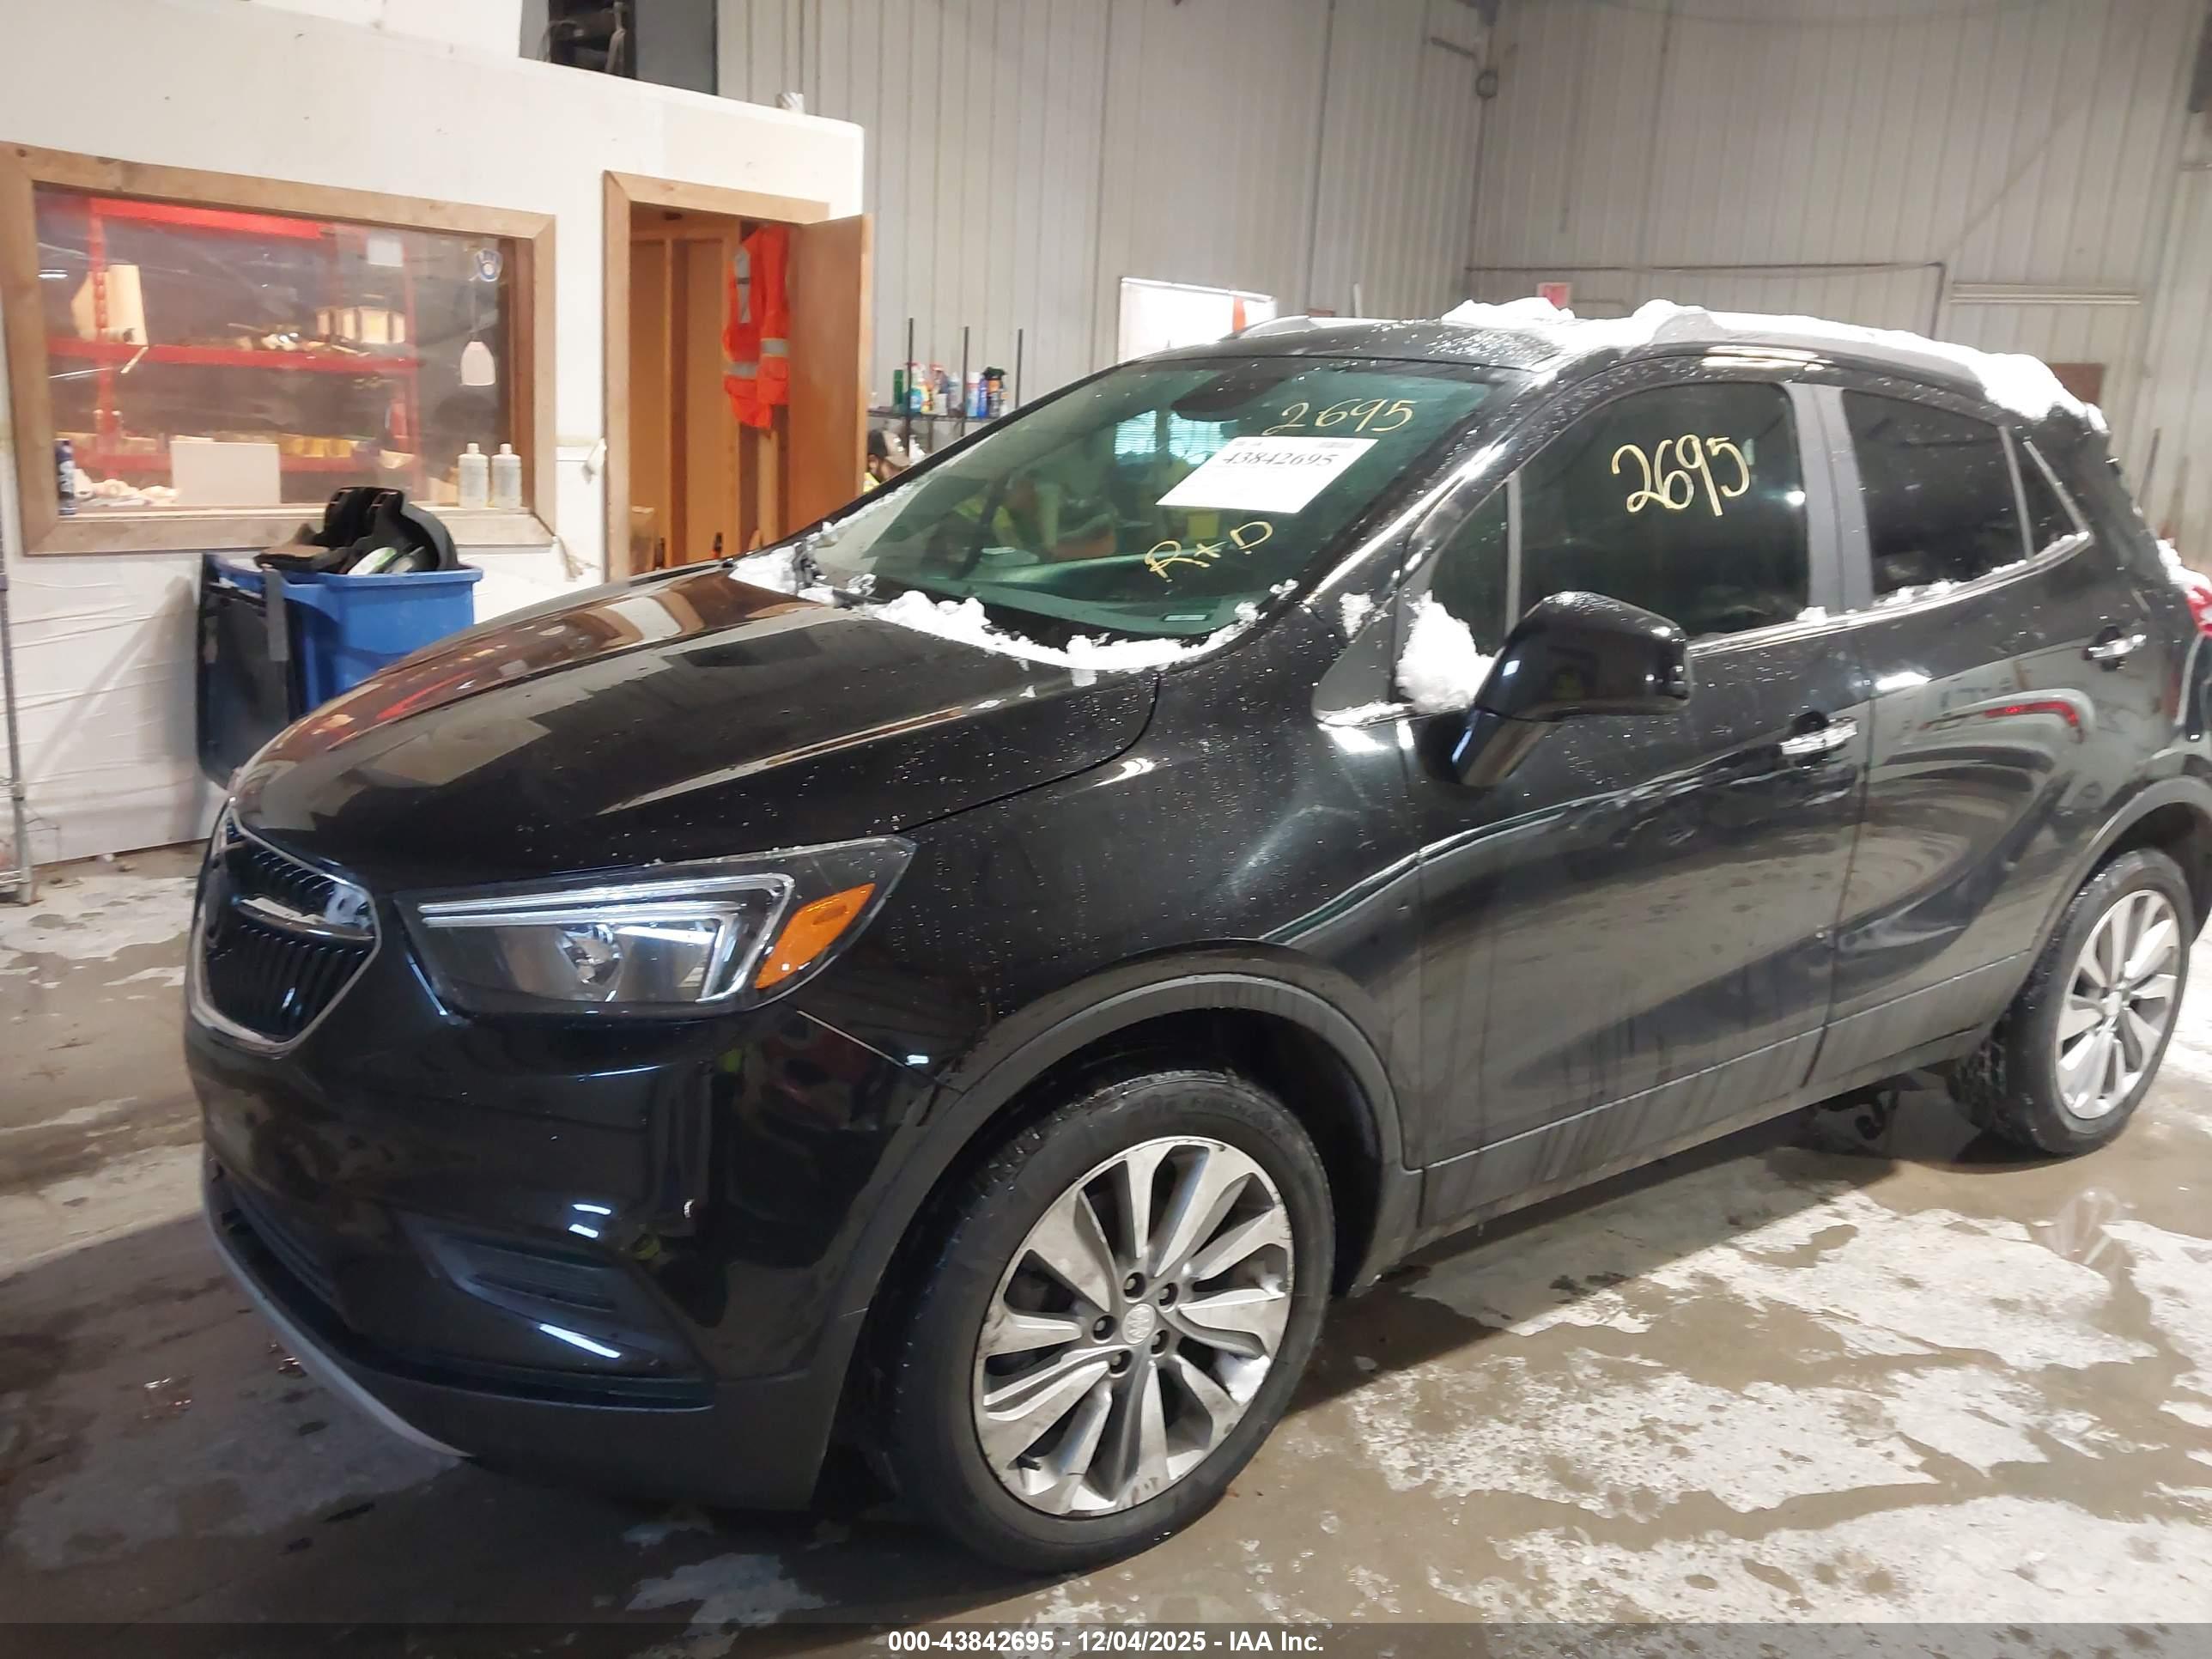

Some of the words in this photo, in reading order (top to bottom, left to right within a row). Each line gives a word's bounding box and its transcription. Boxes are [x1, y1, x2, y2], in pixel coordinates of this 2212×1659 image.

[1261, 398, 1418, 436] 2695
[1223, 452, 1340, 466] 43842695
[1611, 434, 1750, 517] 2695
